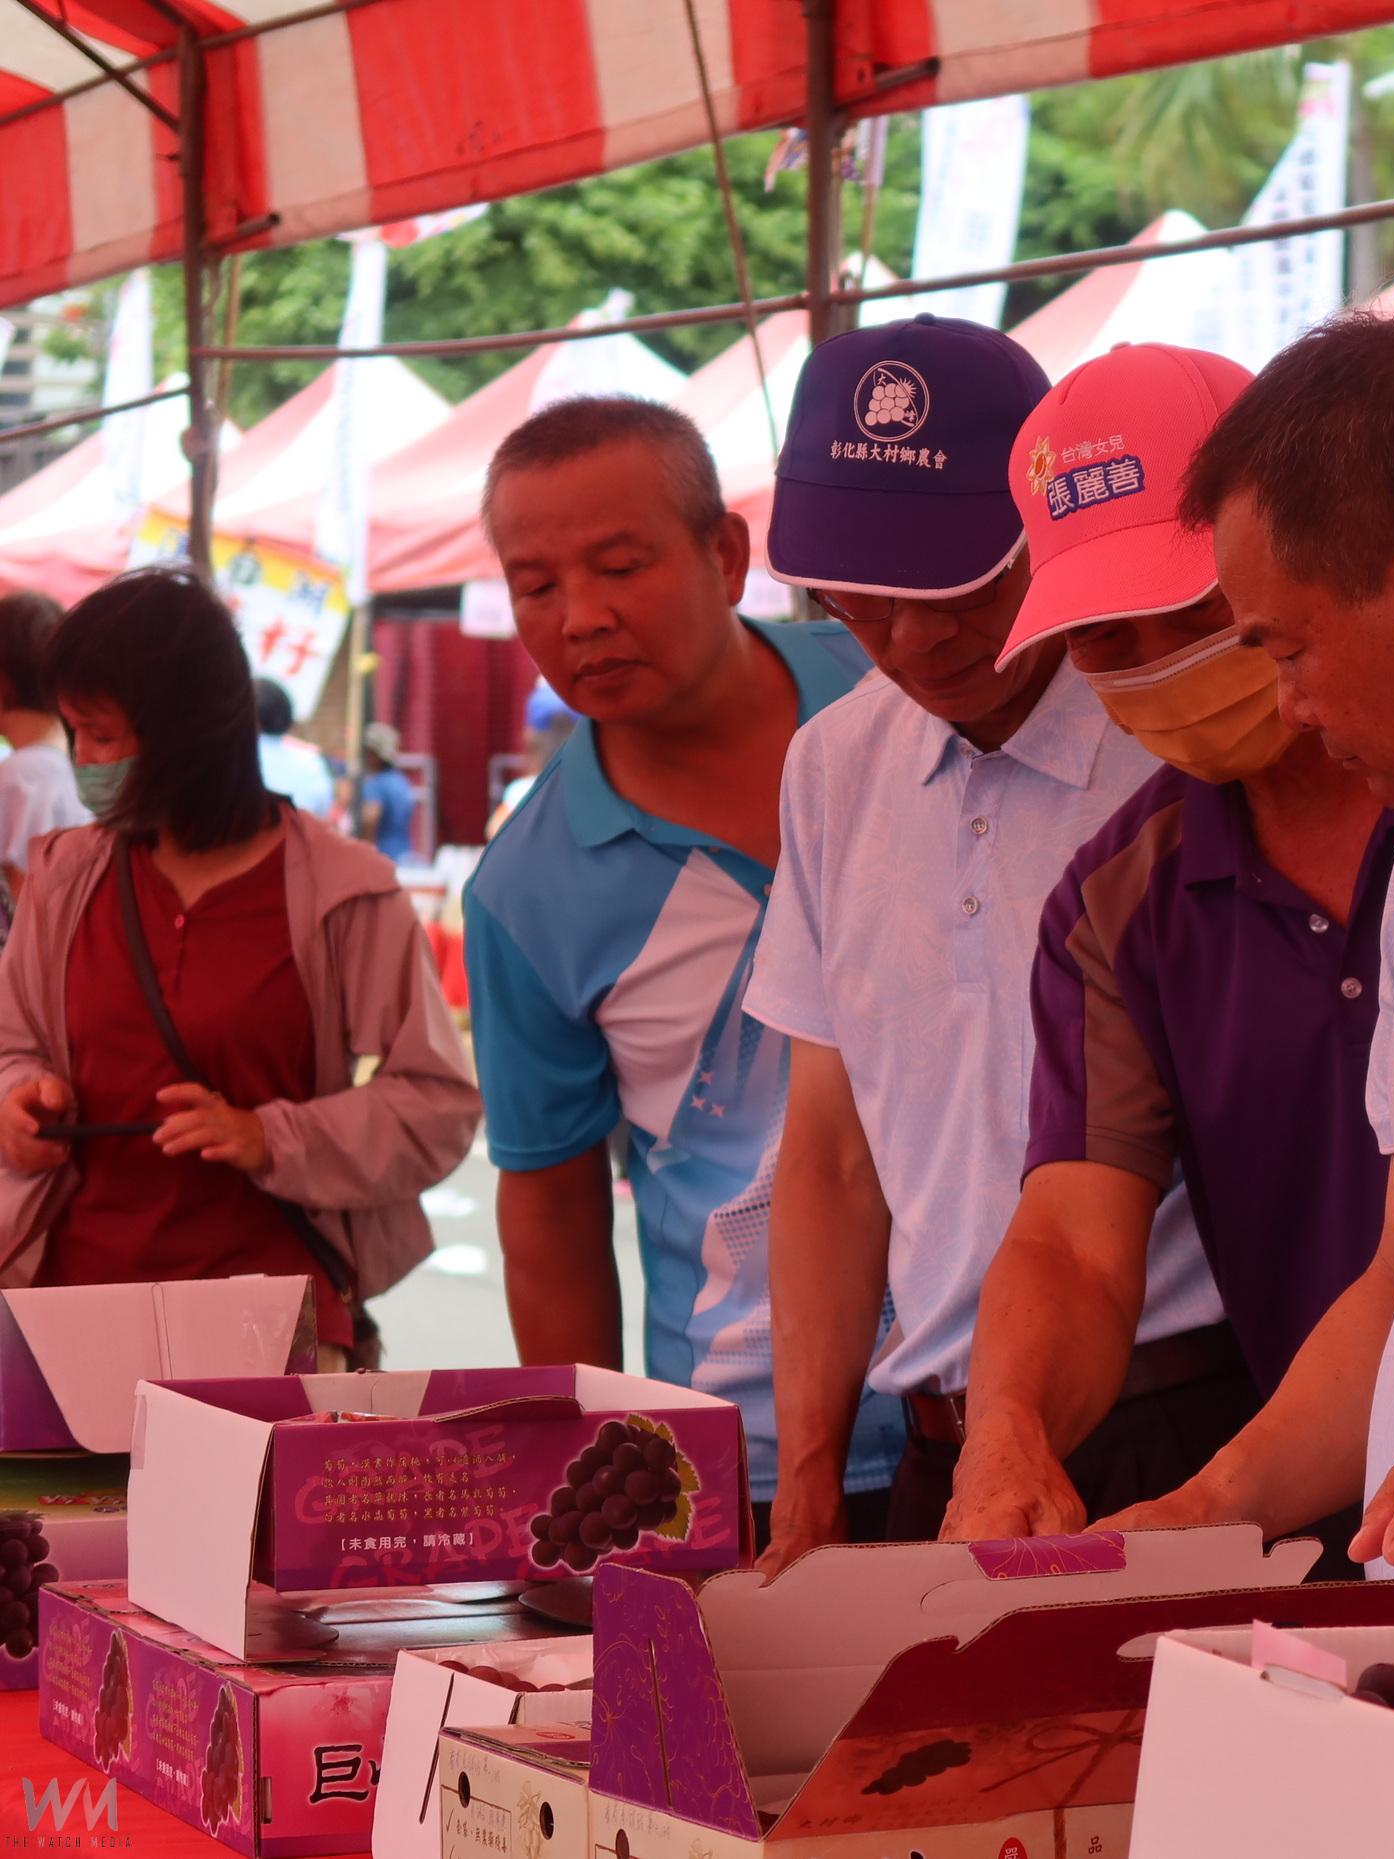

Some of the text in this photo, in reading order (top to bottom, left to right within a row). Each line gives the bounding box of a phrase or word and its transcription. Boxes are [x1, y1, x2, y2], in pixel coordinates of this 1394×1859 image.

[830, 440, 948, 470] 彰化縣大村鄉農會
[1047, 458, 1140, 517] 張麗善
[308, 1743, 383, 1804] 巨
